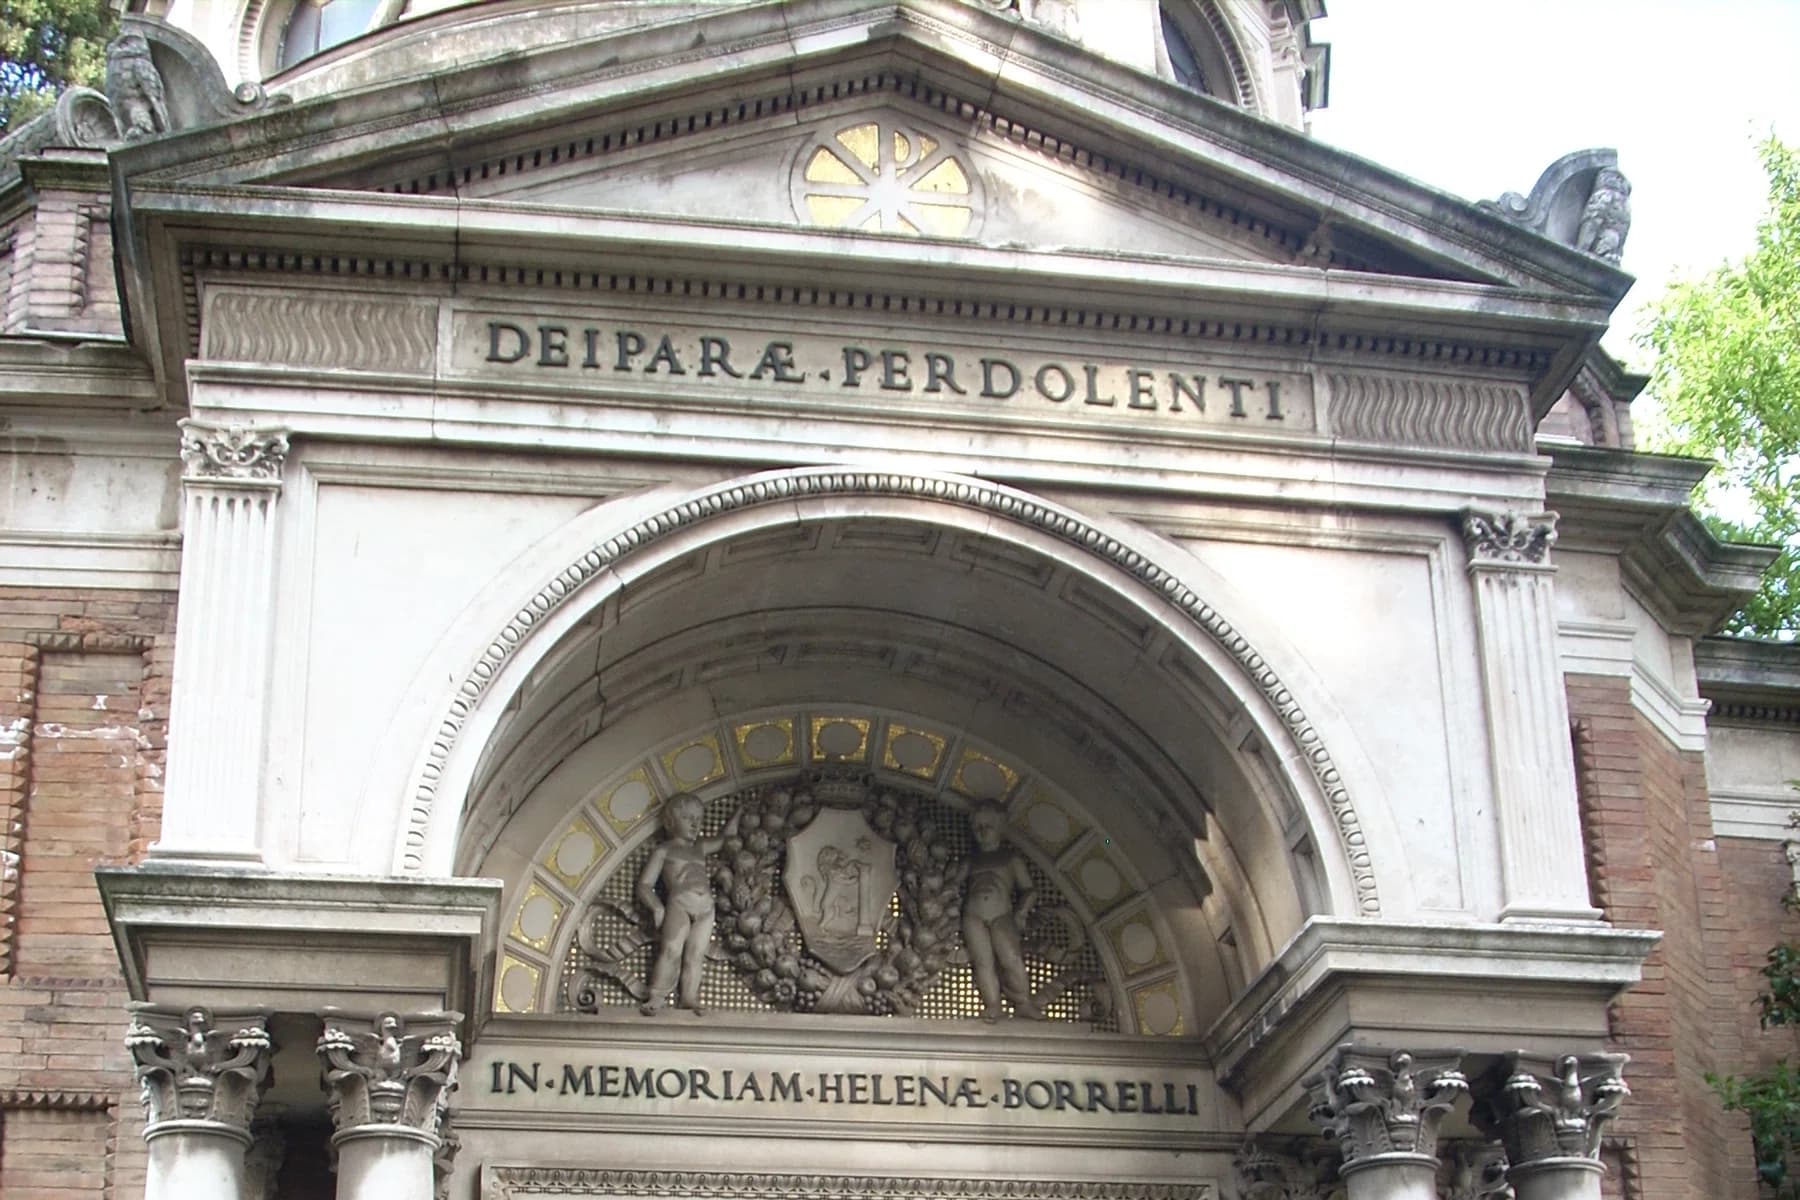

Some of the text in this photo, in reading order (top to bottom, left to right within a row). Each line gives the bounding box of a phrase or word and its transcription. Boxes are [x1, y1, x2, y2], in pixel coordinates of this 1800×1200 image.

[841, 345, 1286, 420] PERDOLENTI
[490, 1061, 541, 1094] IN
[559, 1063, 803, 1102] MEMORIAM
[1001, 1078, 1200, 1115] BORRELLI
